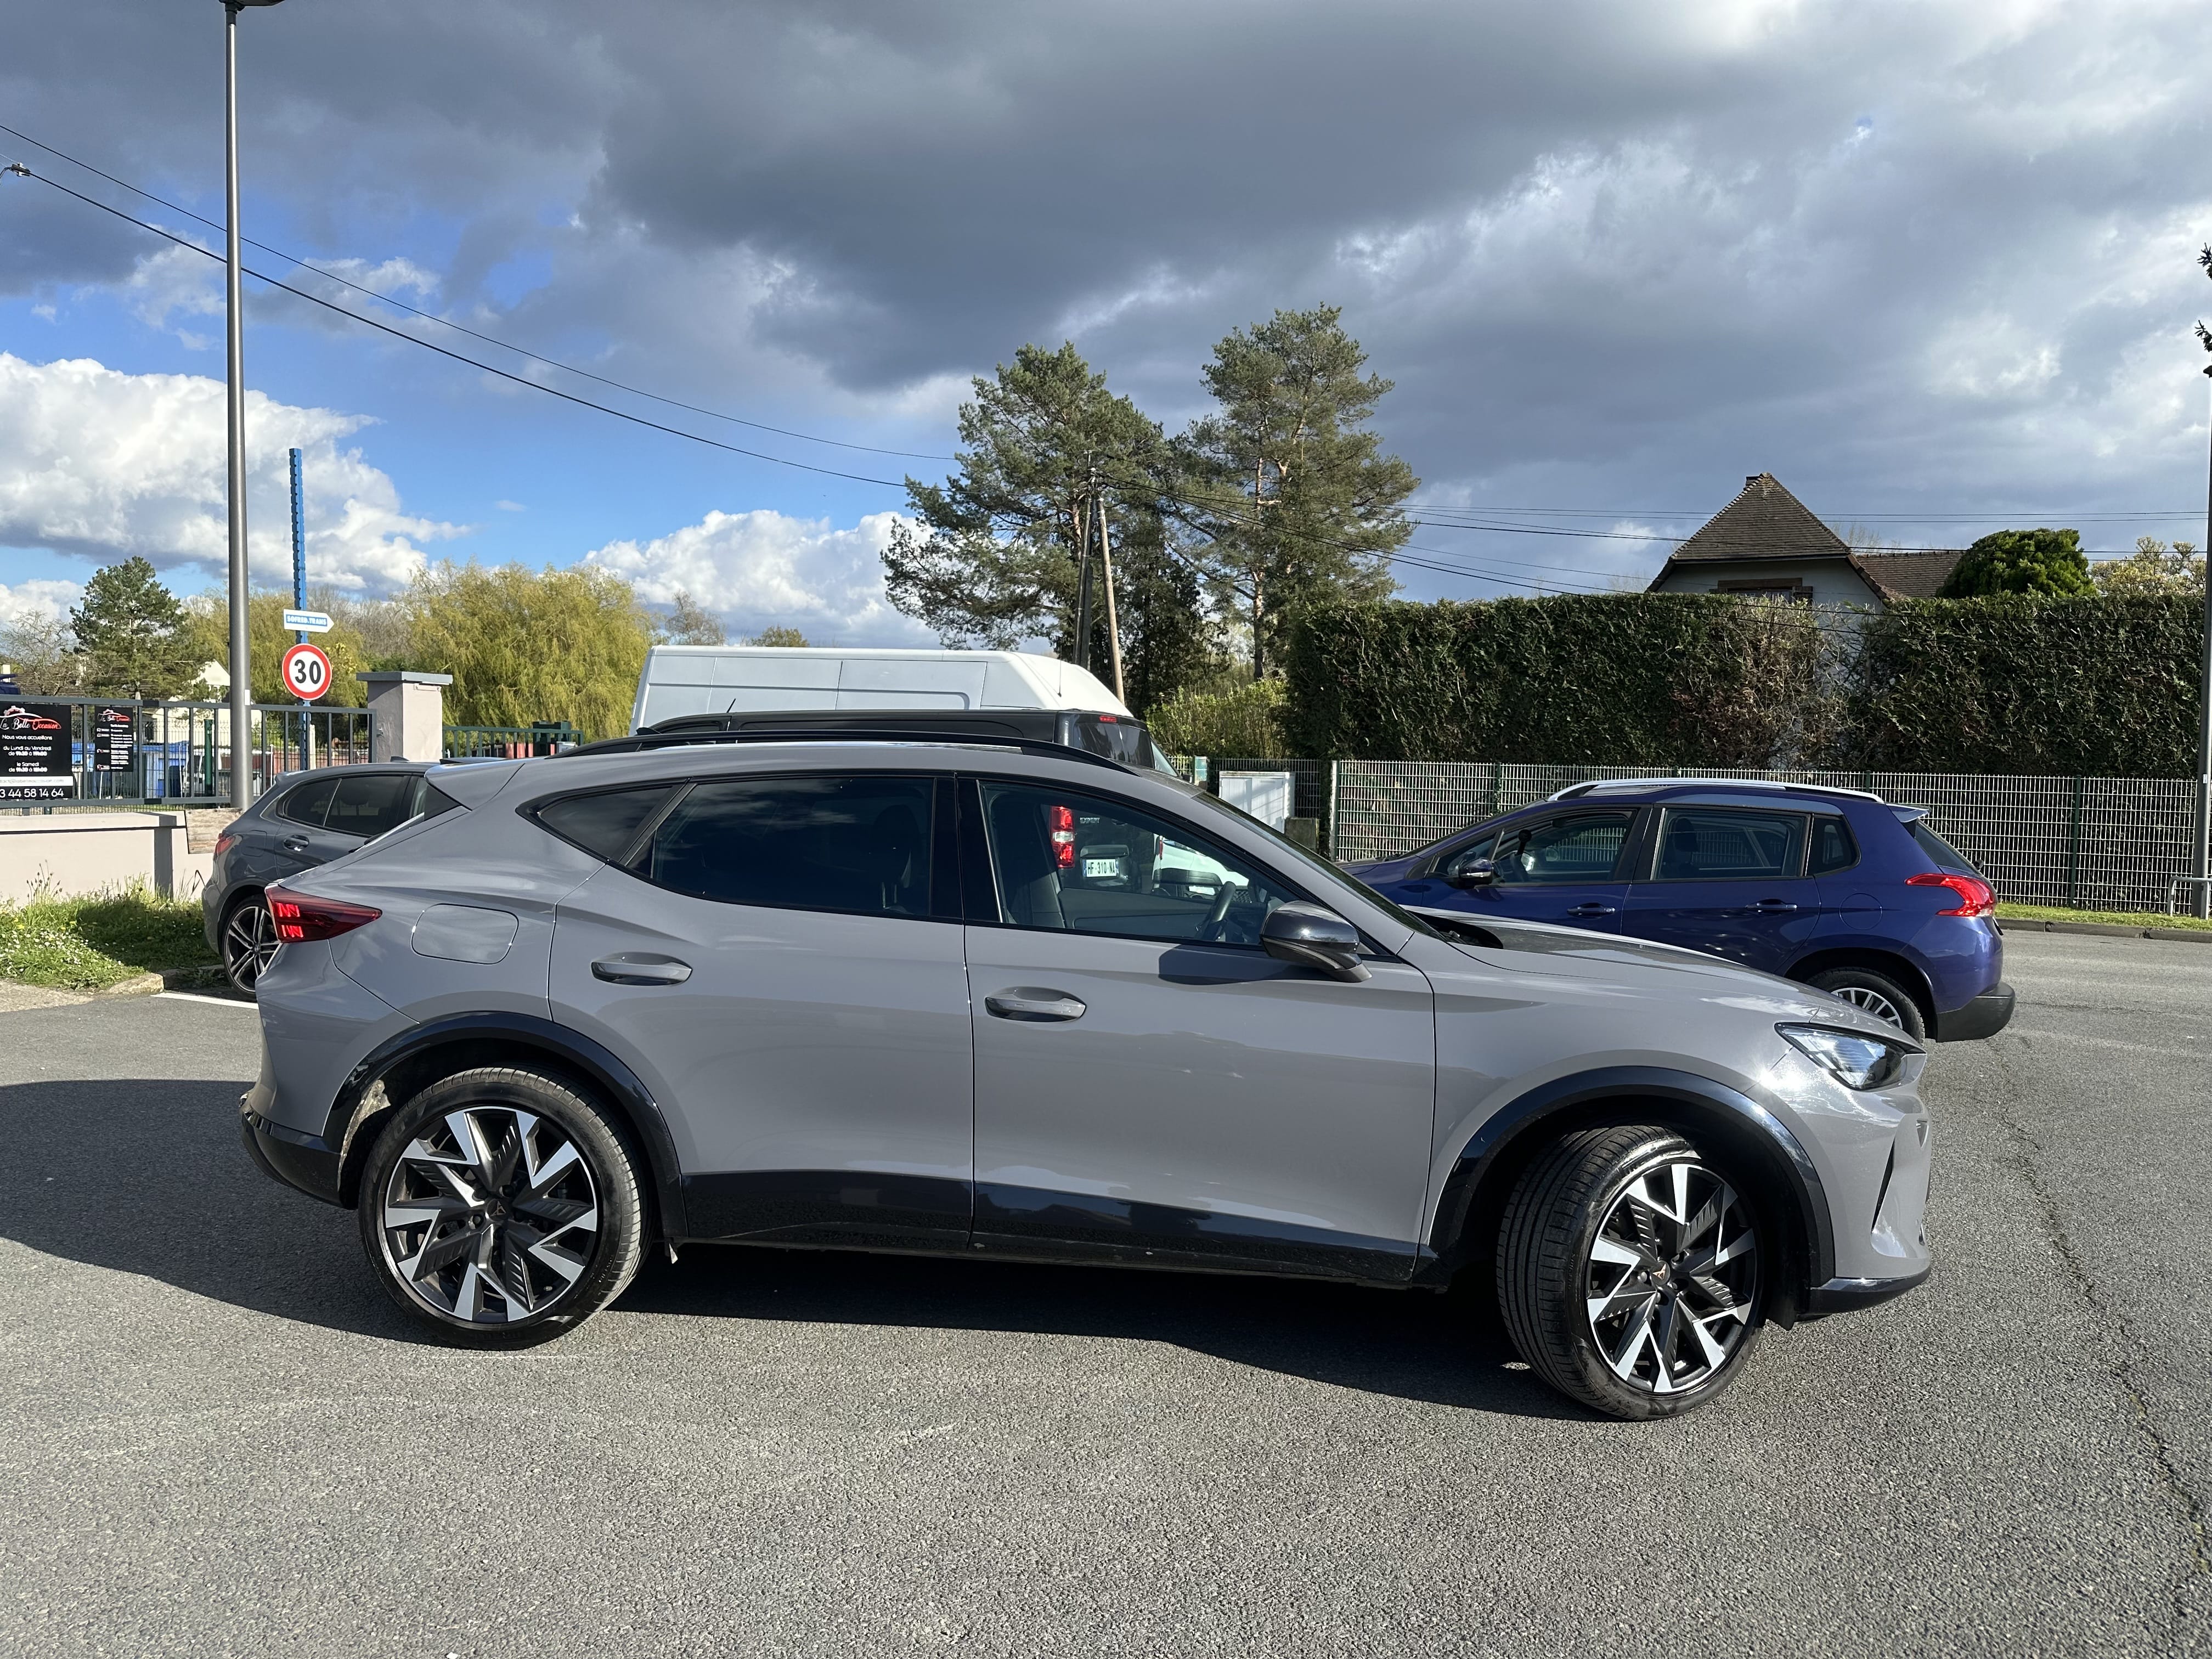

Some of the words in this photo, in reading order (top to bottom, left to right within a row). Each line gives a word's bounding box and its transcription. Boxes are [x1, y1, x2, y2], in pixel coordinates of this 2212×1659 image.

[294, 659, 321, 685] 30
[12, 718, 30, 730] Belle
[32, 719, 58, 730] Occasion
[8, 789, 21, 798] 44
[24, 788, 37, 798] 58
[39, 788, 49, 797] 14
[51, 788, 64, 797] 64
